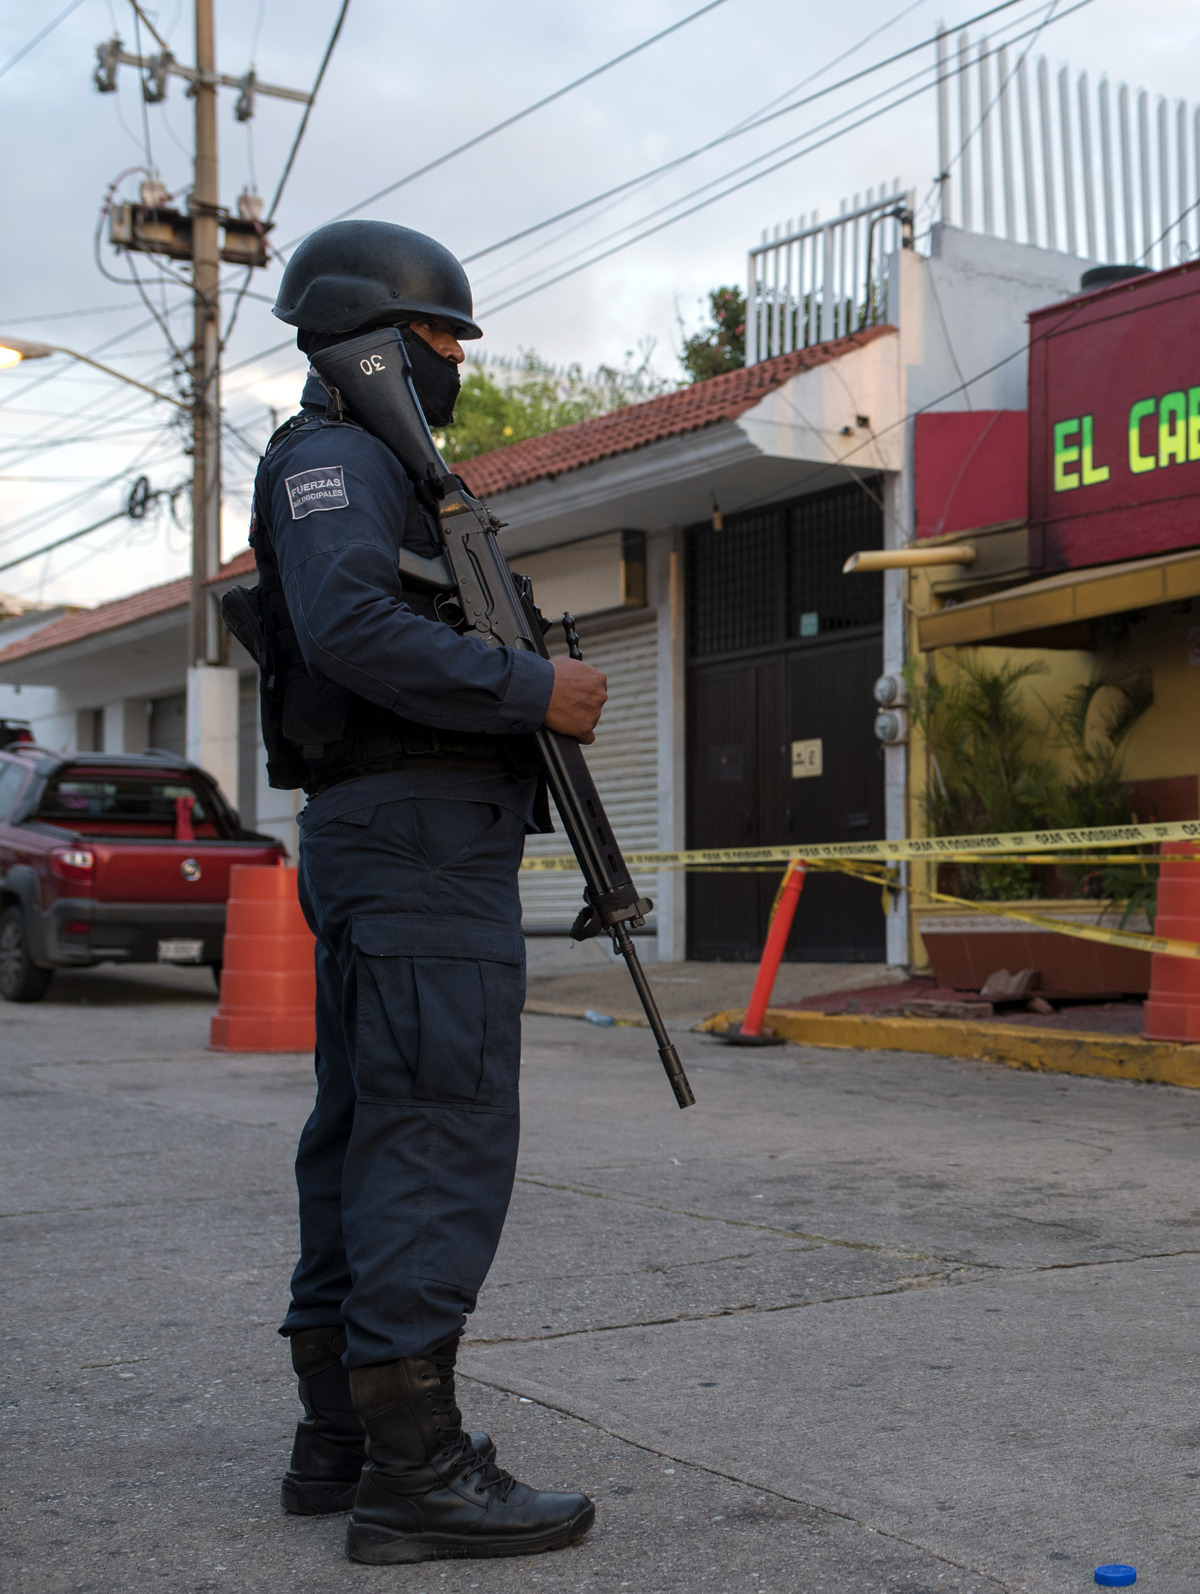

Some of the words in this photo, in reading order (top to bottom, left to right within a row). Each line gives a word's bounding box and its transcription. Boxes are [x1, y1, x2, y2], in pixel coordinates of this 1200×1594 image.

[359, 354, 386, 376] 30
[1053, 413, 1111, 493] EL
[291, 478, 341, 498] FUERZAS
[293, 489, 343, 508] MUNICIPALES
